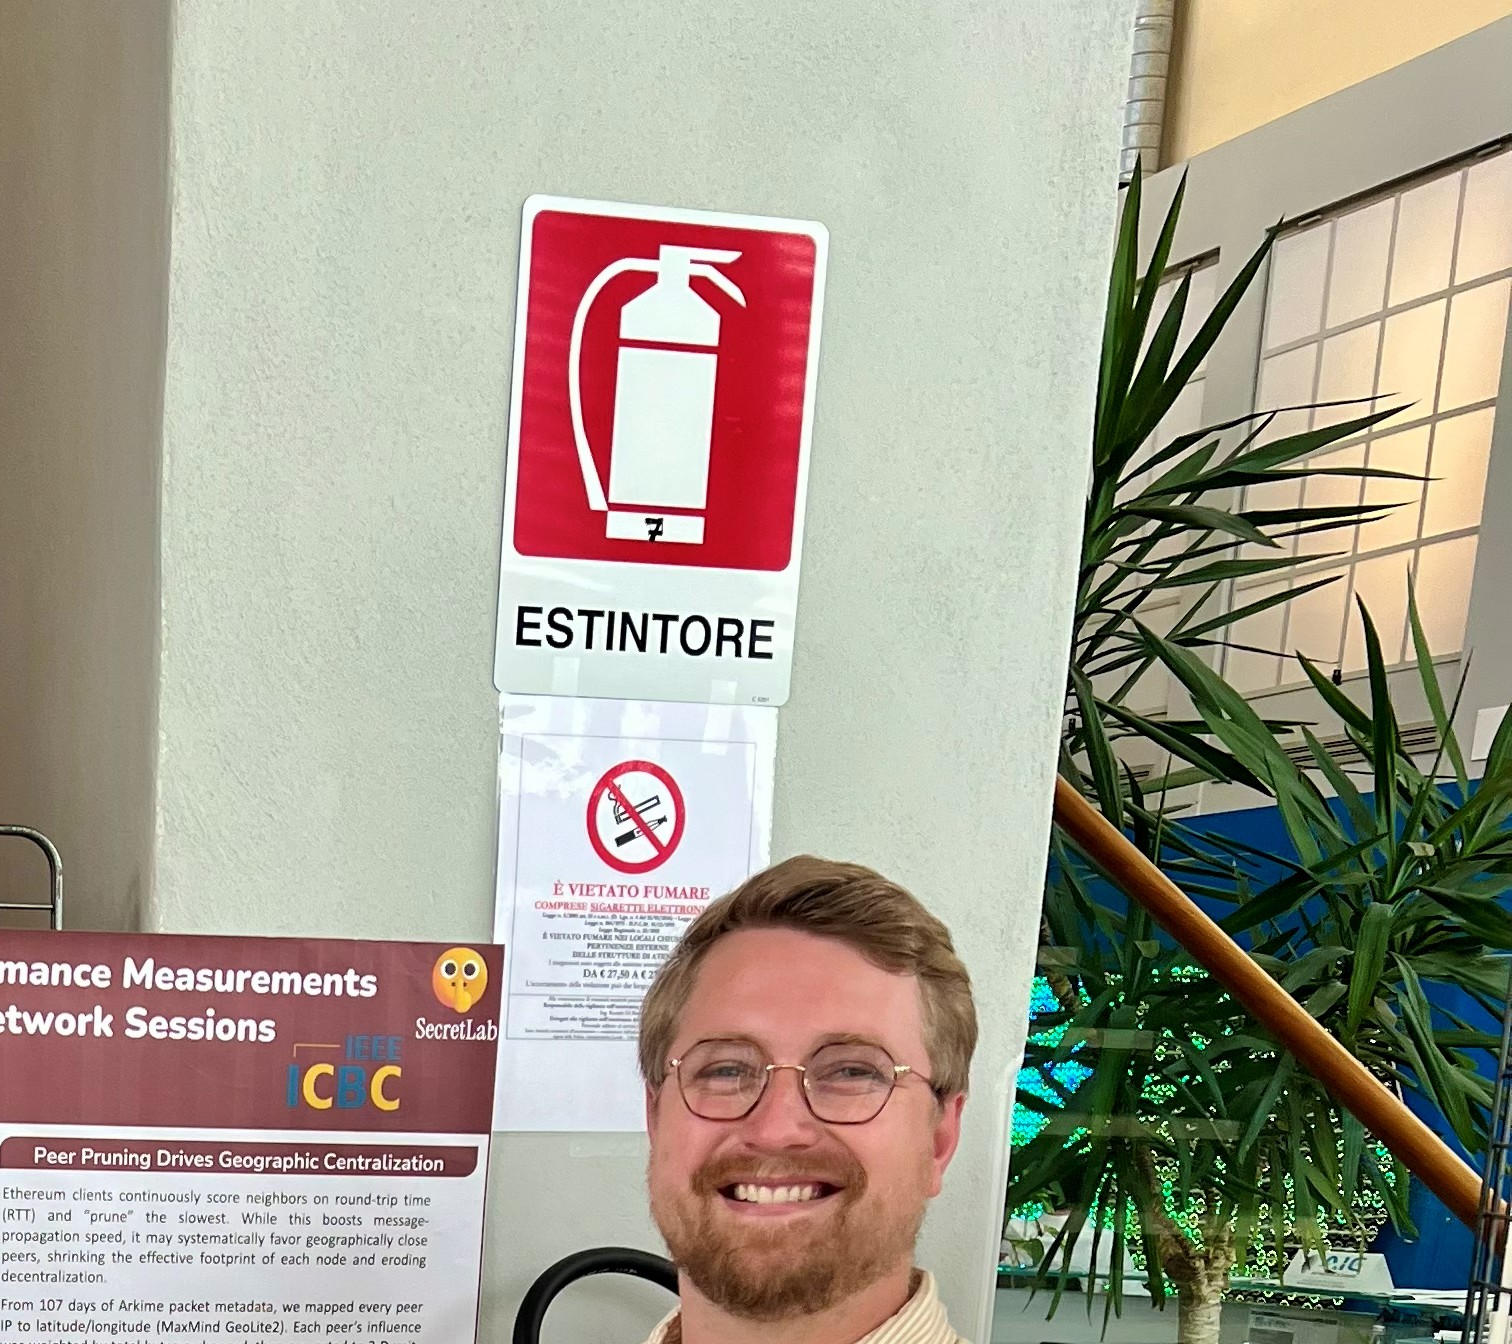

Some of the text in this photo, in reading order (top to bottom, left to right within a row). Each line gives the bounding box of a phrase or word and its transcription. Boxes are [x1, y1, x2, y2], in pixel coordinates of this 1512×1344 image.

[645, 518, 663, 542] 7
[515, 606, 775, 660] ESTINTORE
[553, 879, 710, 900] È VIETATO FUMARE
[535, 901, 587, 909] COMPRESE
[542, 931, 547, 939] È
[549, 932, 581, 940] VIETATO
[582, 933, 613, 941] FUMARE
[122, 957, 377, 997] Measurements
[582, 968, 597, 978] DA
[631, 970, 638, 979] A
[124, 1006, 276, 1042] Sessions
[416, 1018, 498, 1040] SecretLab
[346, 1036, 403, 1060] IEEE
[287, 1064, 402, 1111] ICBC
[34, 1146, 444, 1172] Peer Pruning Drives Geographic Centralization
